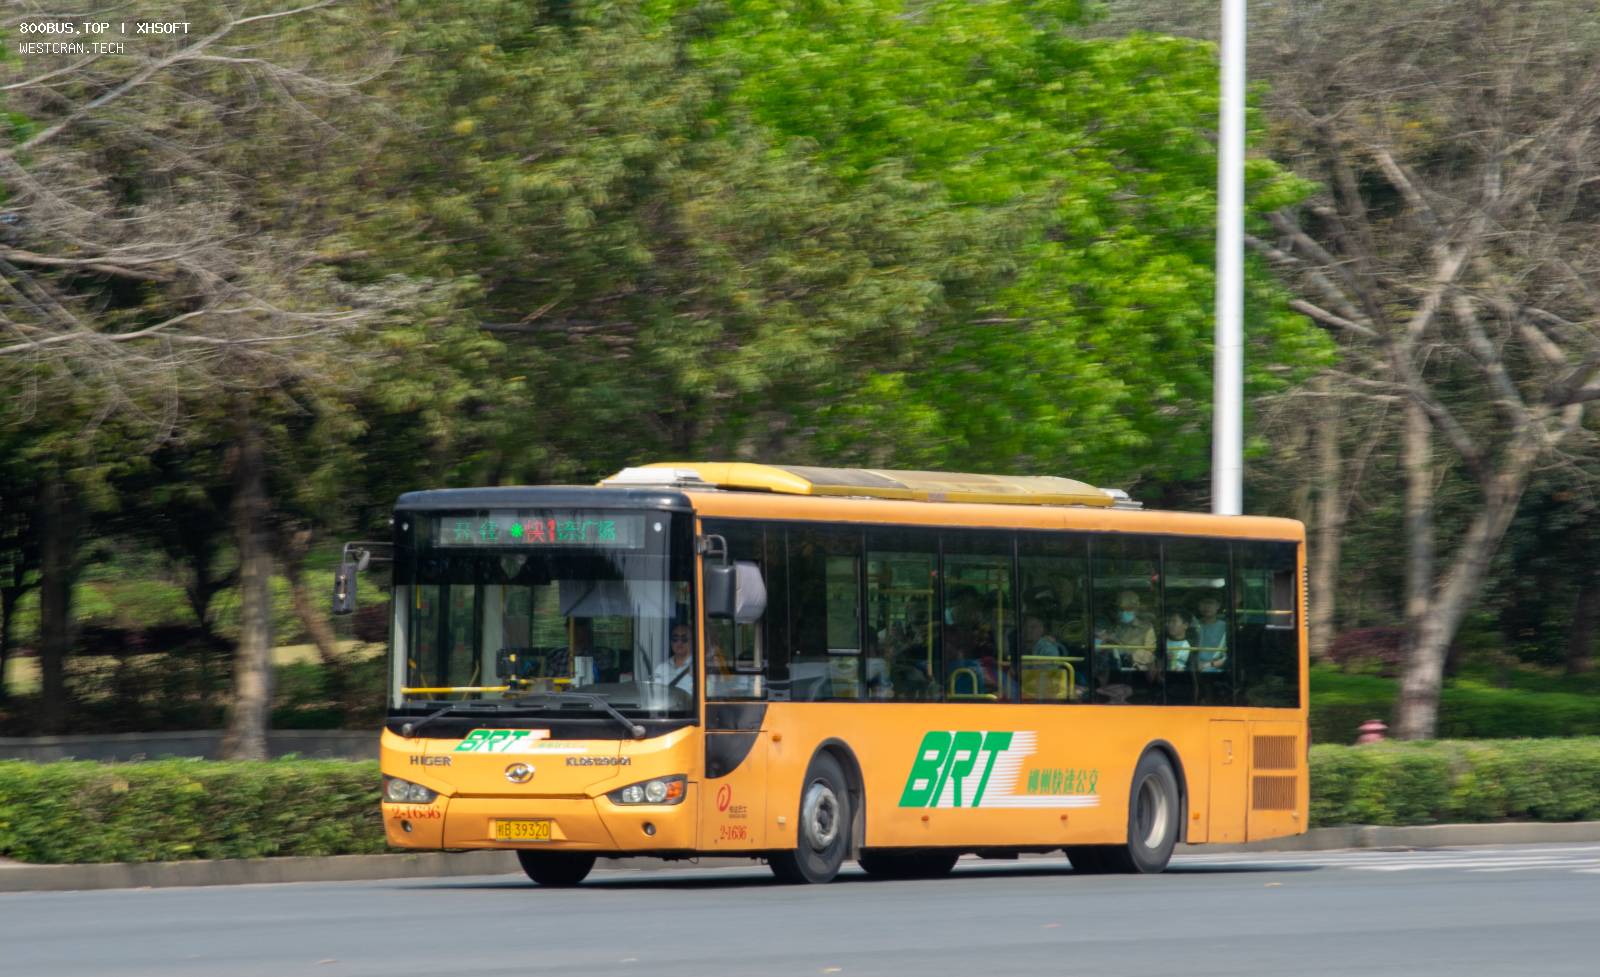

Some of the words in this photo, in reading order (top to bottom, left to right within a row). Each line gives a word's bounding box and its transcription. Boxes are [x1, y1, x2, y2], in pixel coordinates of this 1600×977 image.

[454, 729, 531, 752] BRT
[410, 755, 451, 766] HIGER
[898, 731, 1014, 807] BRT
